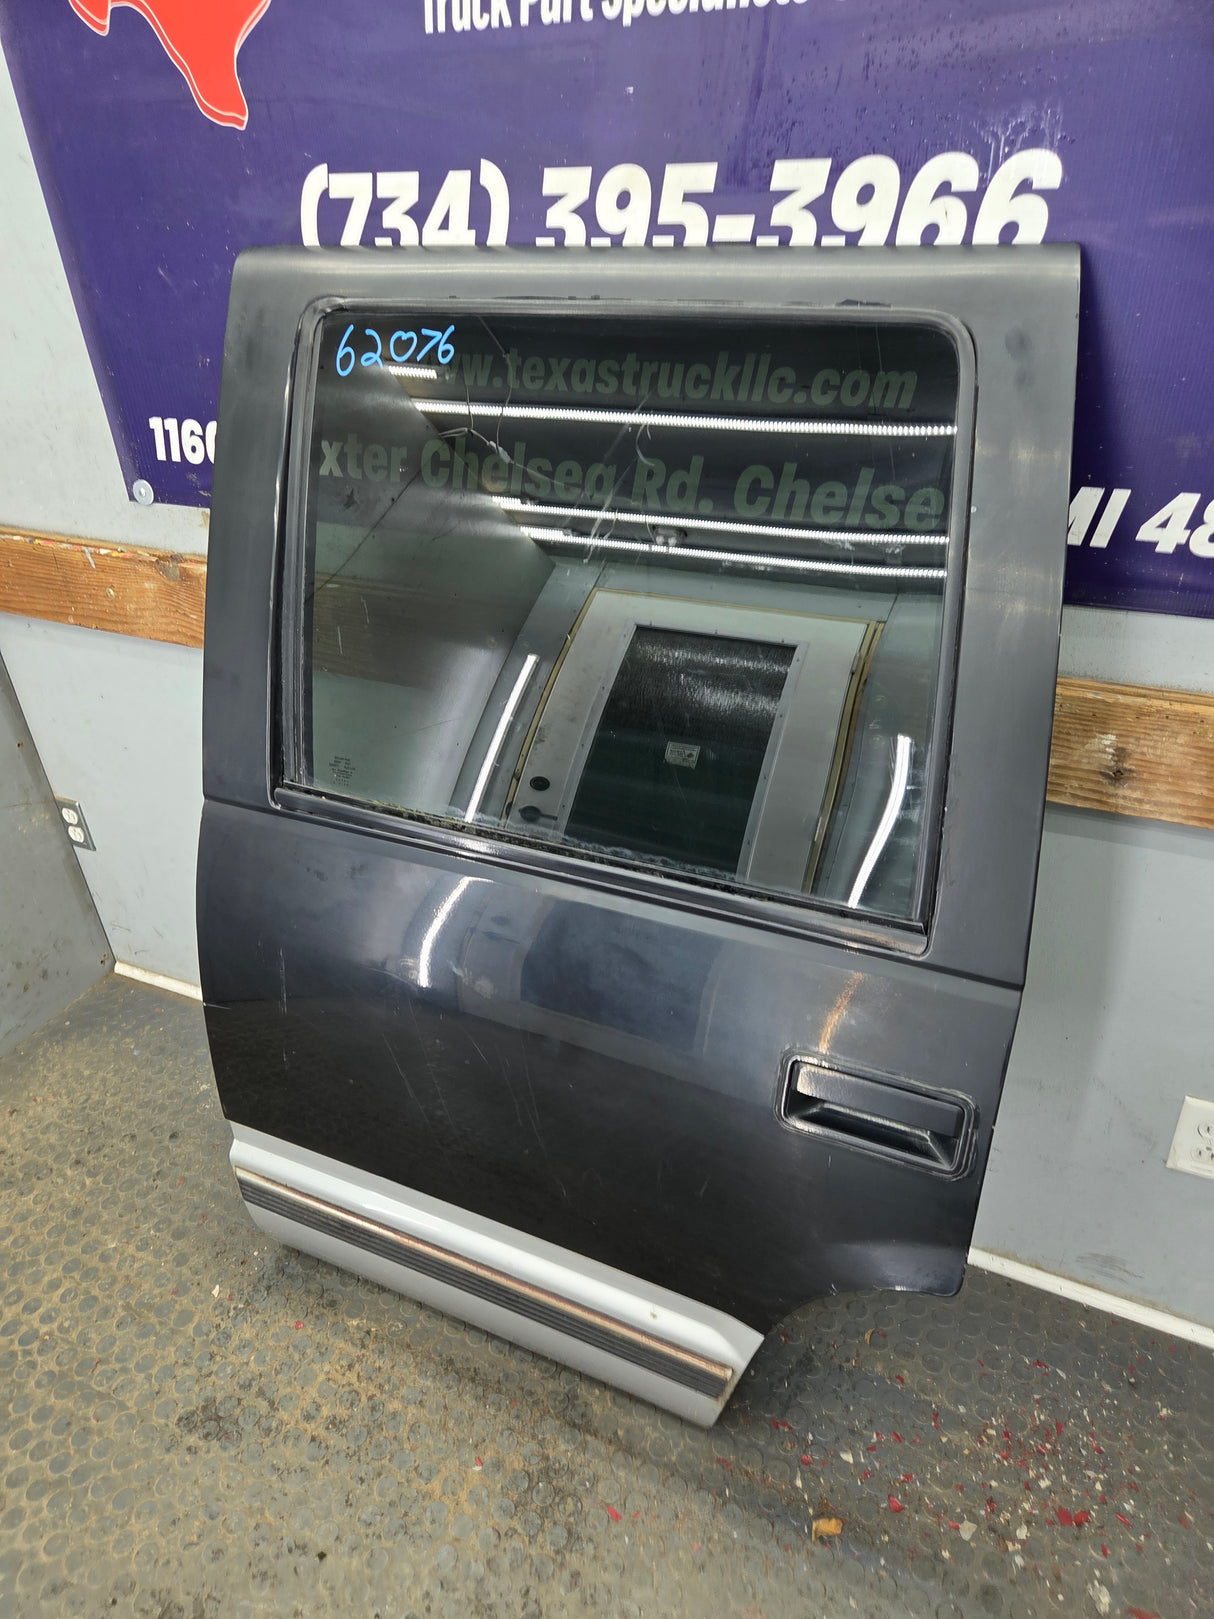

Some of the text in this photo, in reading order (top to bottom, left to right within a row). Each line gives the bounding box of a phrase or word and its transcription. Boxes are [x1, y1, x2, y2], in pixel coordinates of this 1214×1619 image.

[300, 147, 1063, 247] (734) 395-3966
[336, 324, 456, 377] 62076
[431, 345, 919, 409] ww.texastruckllc.com
[420, 435, 617, 501] Chelsea
[631, 454, 714, 514] Rd.
